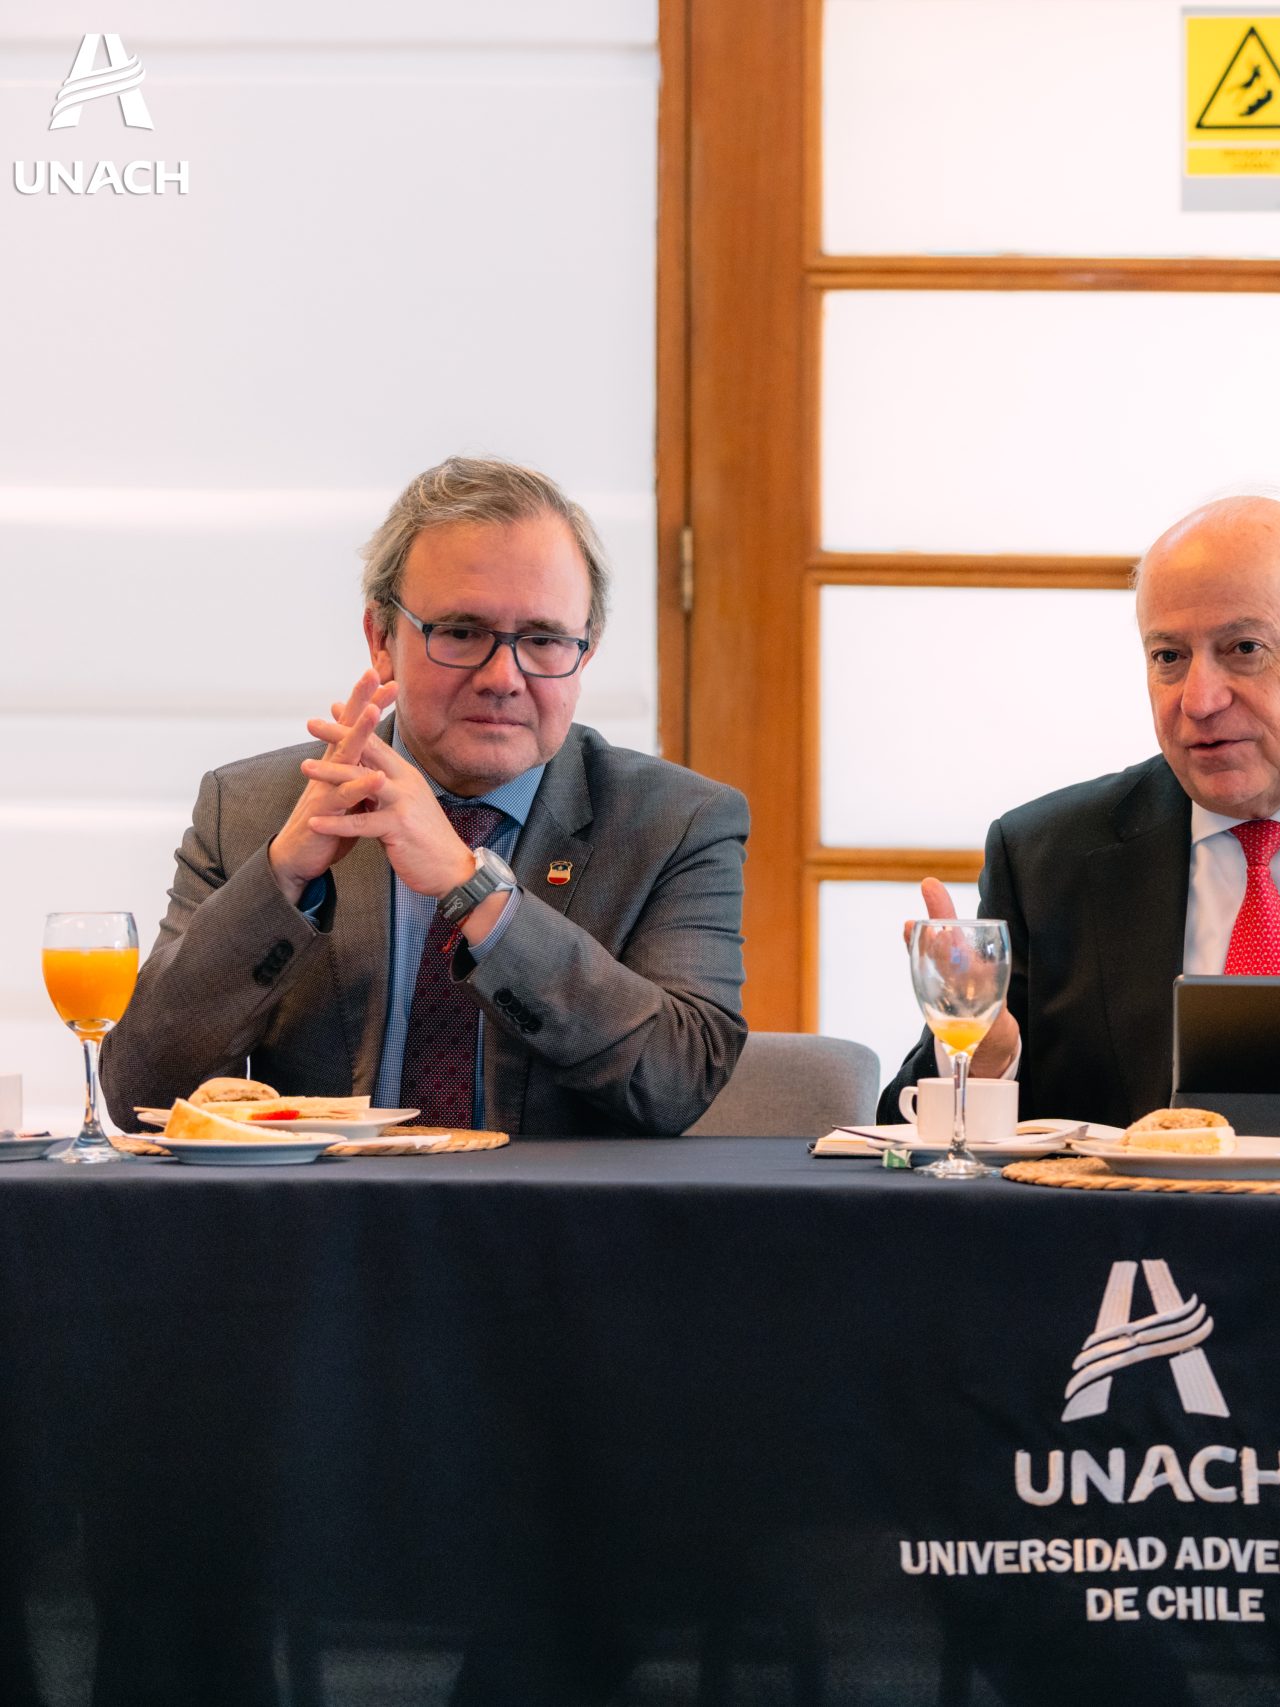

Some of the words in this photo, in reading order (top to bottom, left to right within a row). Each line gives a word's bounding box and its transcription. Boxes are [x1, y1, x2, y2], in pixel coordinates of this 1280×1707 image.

[899, 1536, 1167, 1576] UNIVERSIDAD
[1086, 1586, 1140, 1621] DE
[1146, 1585, 1265, 1622] CHILE
